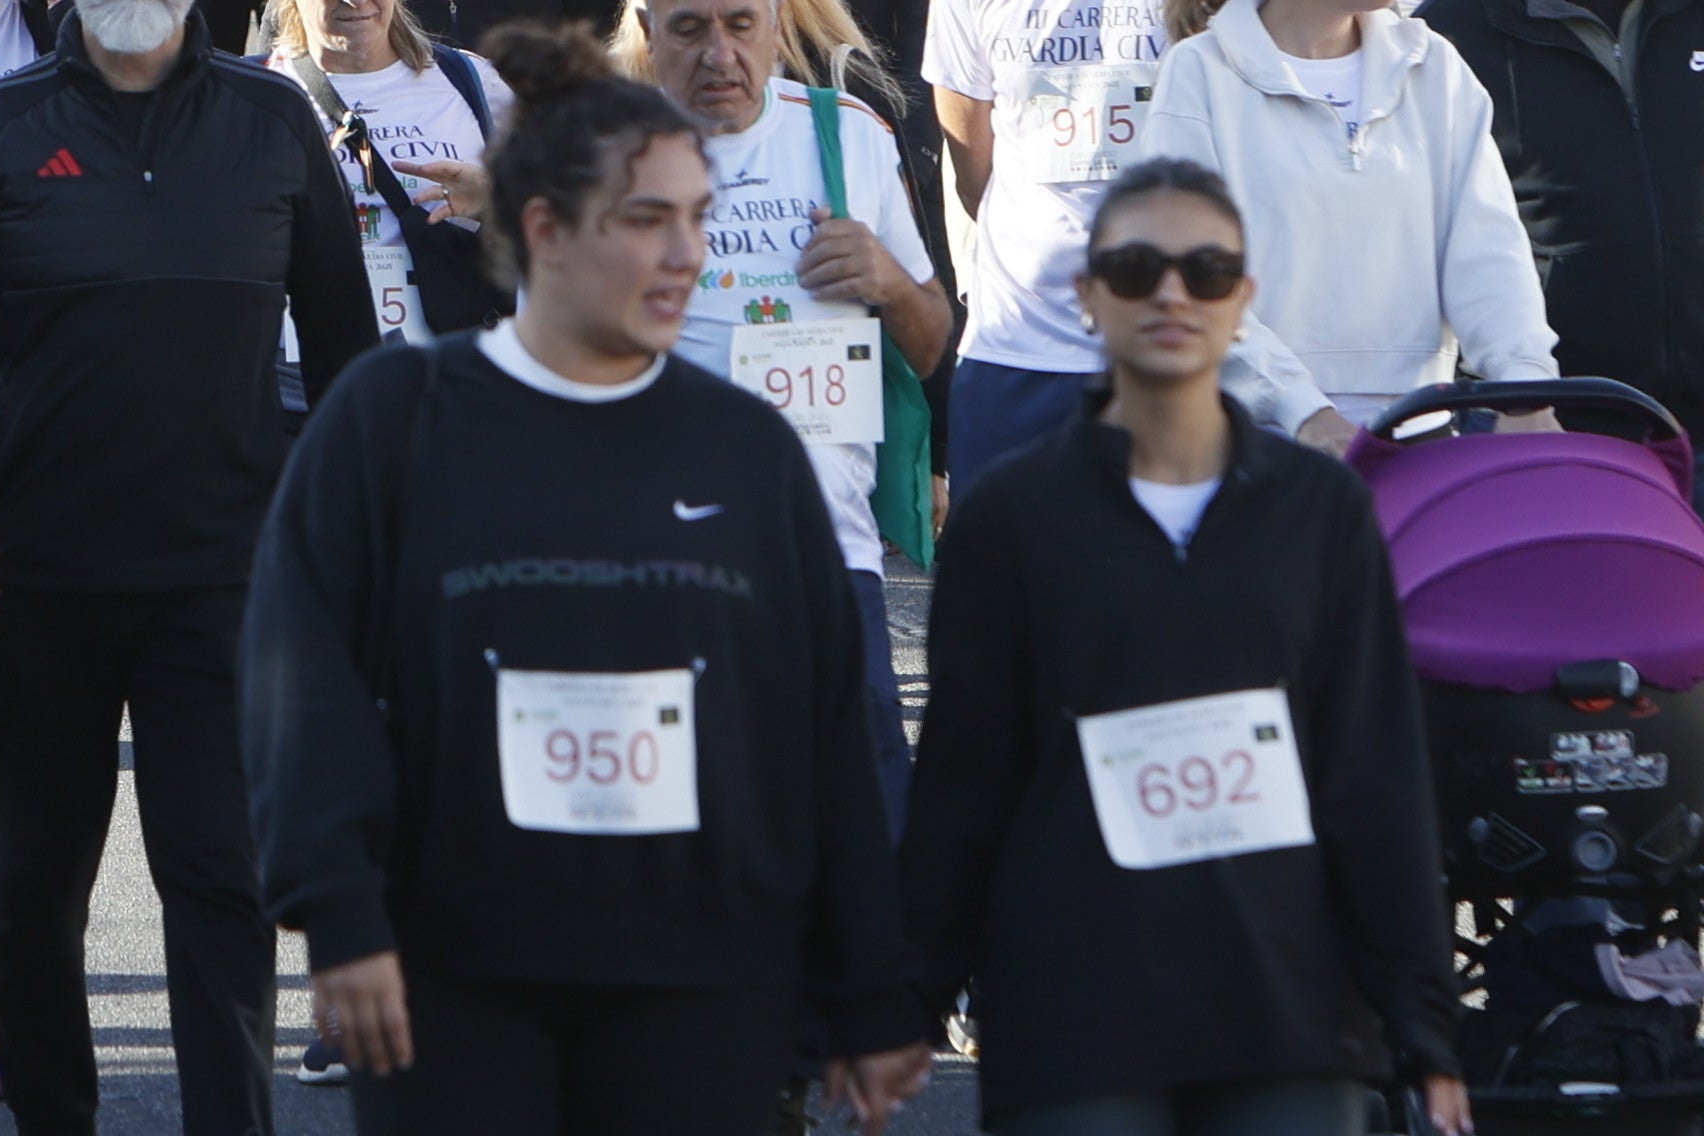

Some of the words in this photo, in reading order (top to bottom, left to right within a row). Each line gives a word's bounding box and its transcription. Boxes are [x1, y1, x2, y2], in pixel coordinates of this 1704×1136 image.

[1058, 6, 1157, 29] CARRERA
[991, 35, 1105, 65] GVARDIA
[1053, 105, 1135, 147] 915
[390, 141, 463, 162] CIVIL
[765, 364, 846, 409] 918
[545, 729, 659, 786] 950
[1134, 748, 1262, 819] 692
